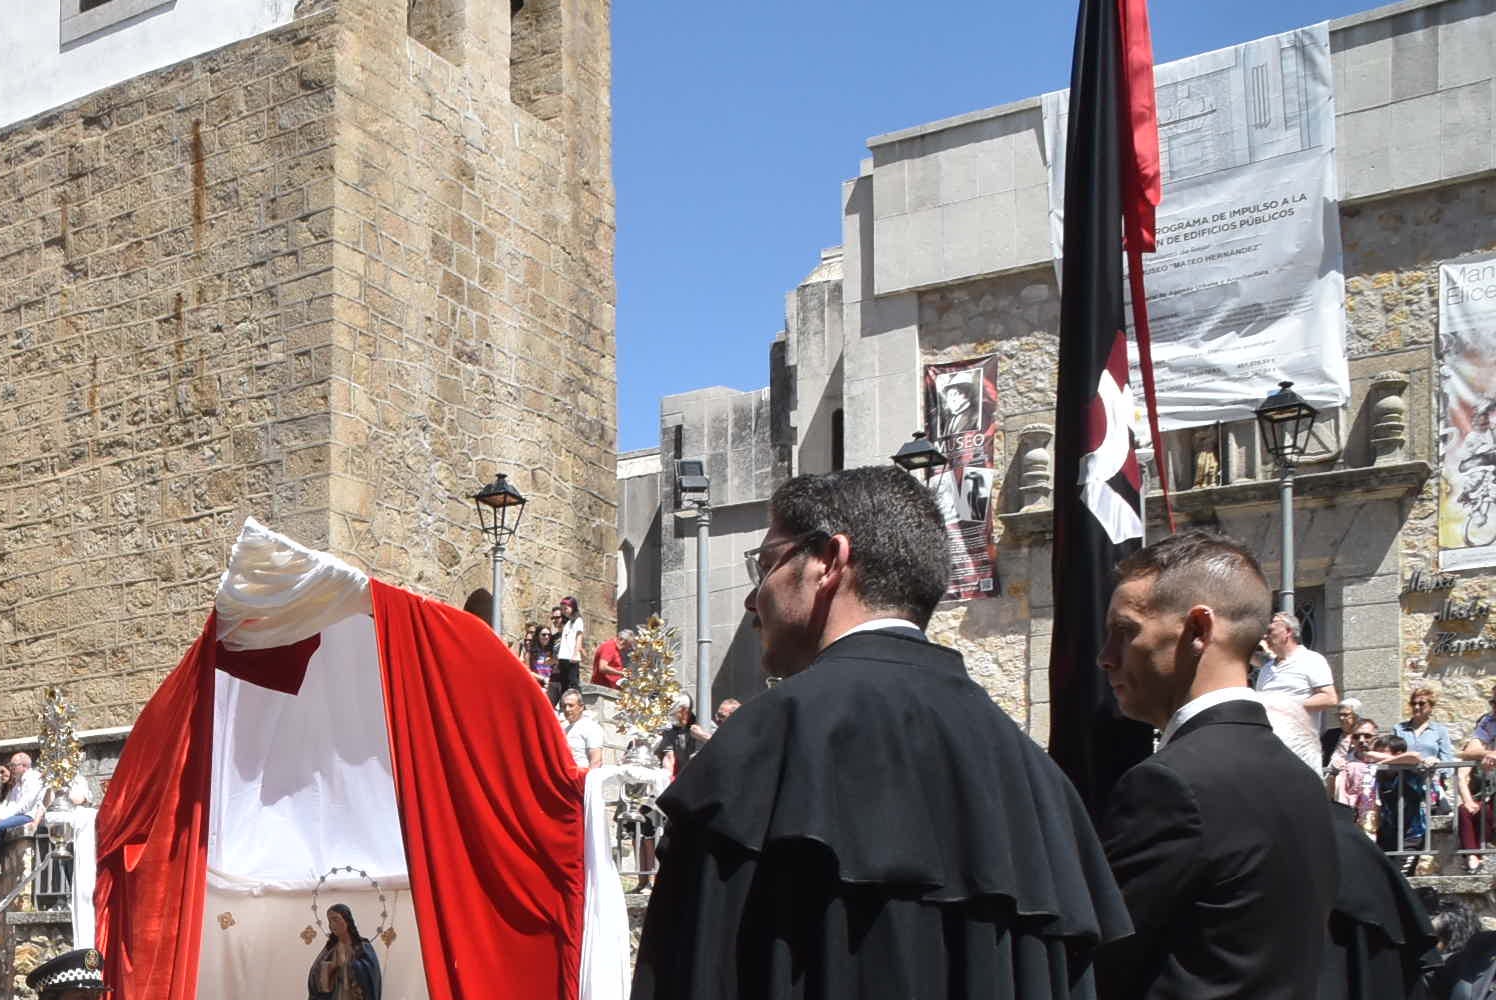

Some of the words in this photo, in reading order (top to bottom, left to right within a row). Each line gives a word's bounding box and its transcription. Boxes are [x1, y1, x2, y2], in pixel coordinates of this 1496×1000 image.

[1155, 217, 1208, 234] ROGRAMA
[1212, 212, 1226, 223] DE
[1229, 200, 1279, 218] IMPULSO
[1282, 197, 1290, 206] A
[1292, 193, 1308, 204] LA
[1167, 235, 1181, 246] DE
[1184, 222, 1238, 241] EDIFICIOS
[1239, 207, 1295, 229] PÚBLICOS
[934, 434, 984, 454] MUSEO
